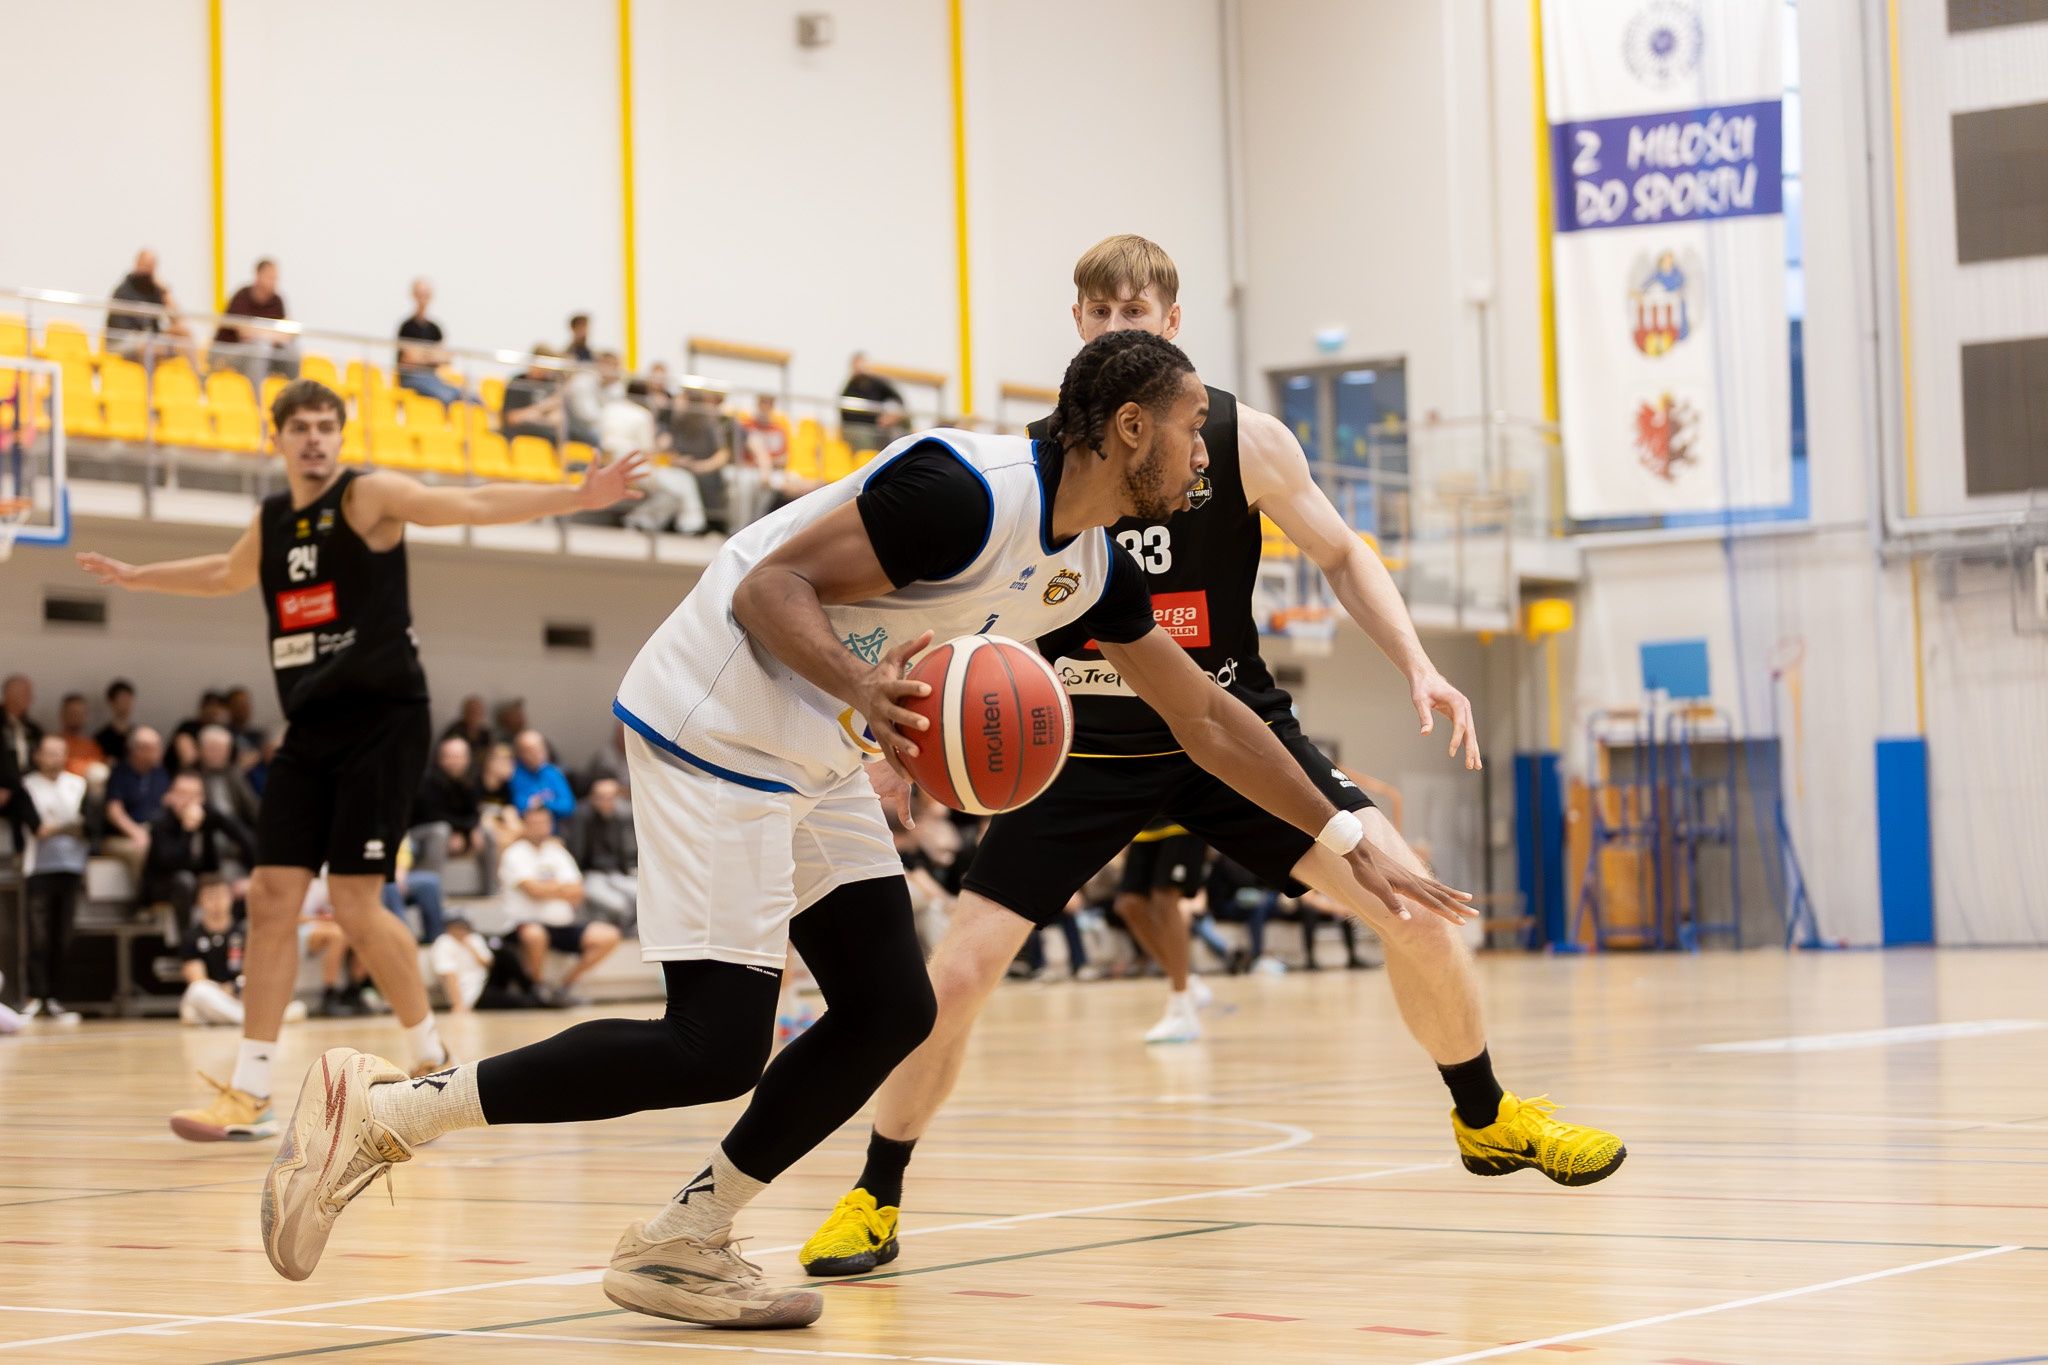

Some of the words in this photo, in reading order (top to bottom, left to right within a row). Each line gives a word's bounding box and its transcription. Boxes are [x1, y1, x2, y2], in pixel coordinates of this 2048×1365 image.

[1574, 178, 1629, 226] DO
[1631, 161, 1759, 222] SPORTU
[287, 544, 318, 582] 24
[1116, 525, 1172, 574] 33
[1153, 606, 1197, 626] erga
[1083, 669, 1122, 687] Tre
[983, 692, 1003, 773] molten
[1031, 706, 1048, 747] FIBA
